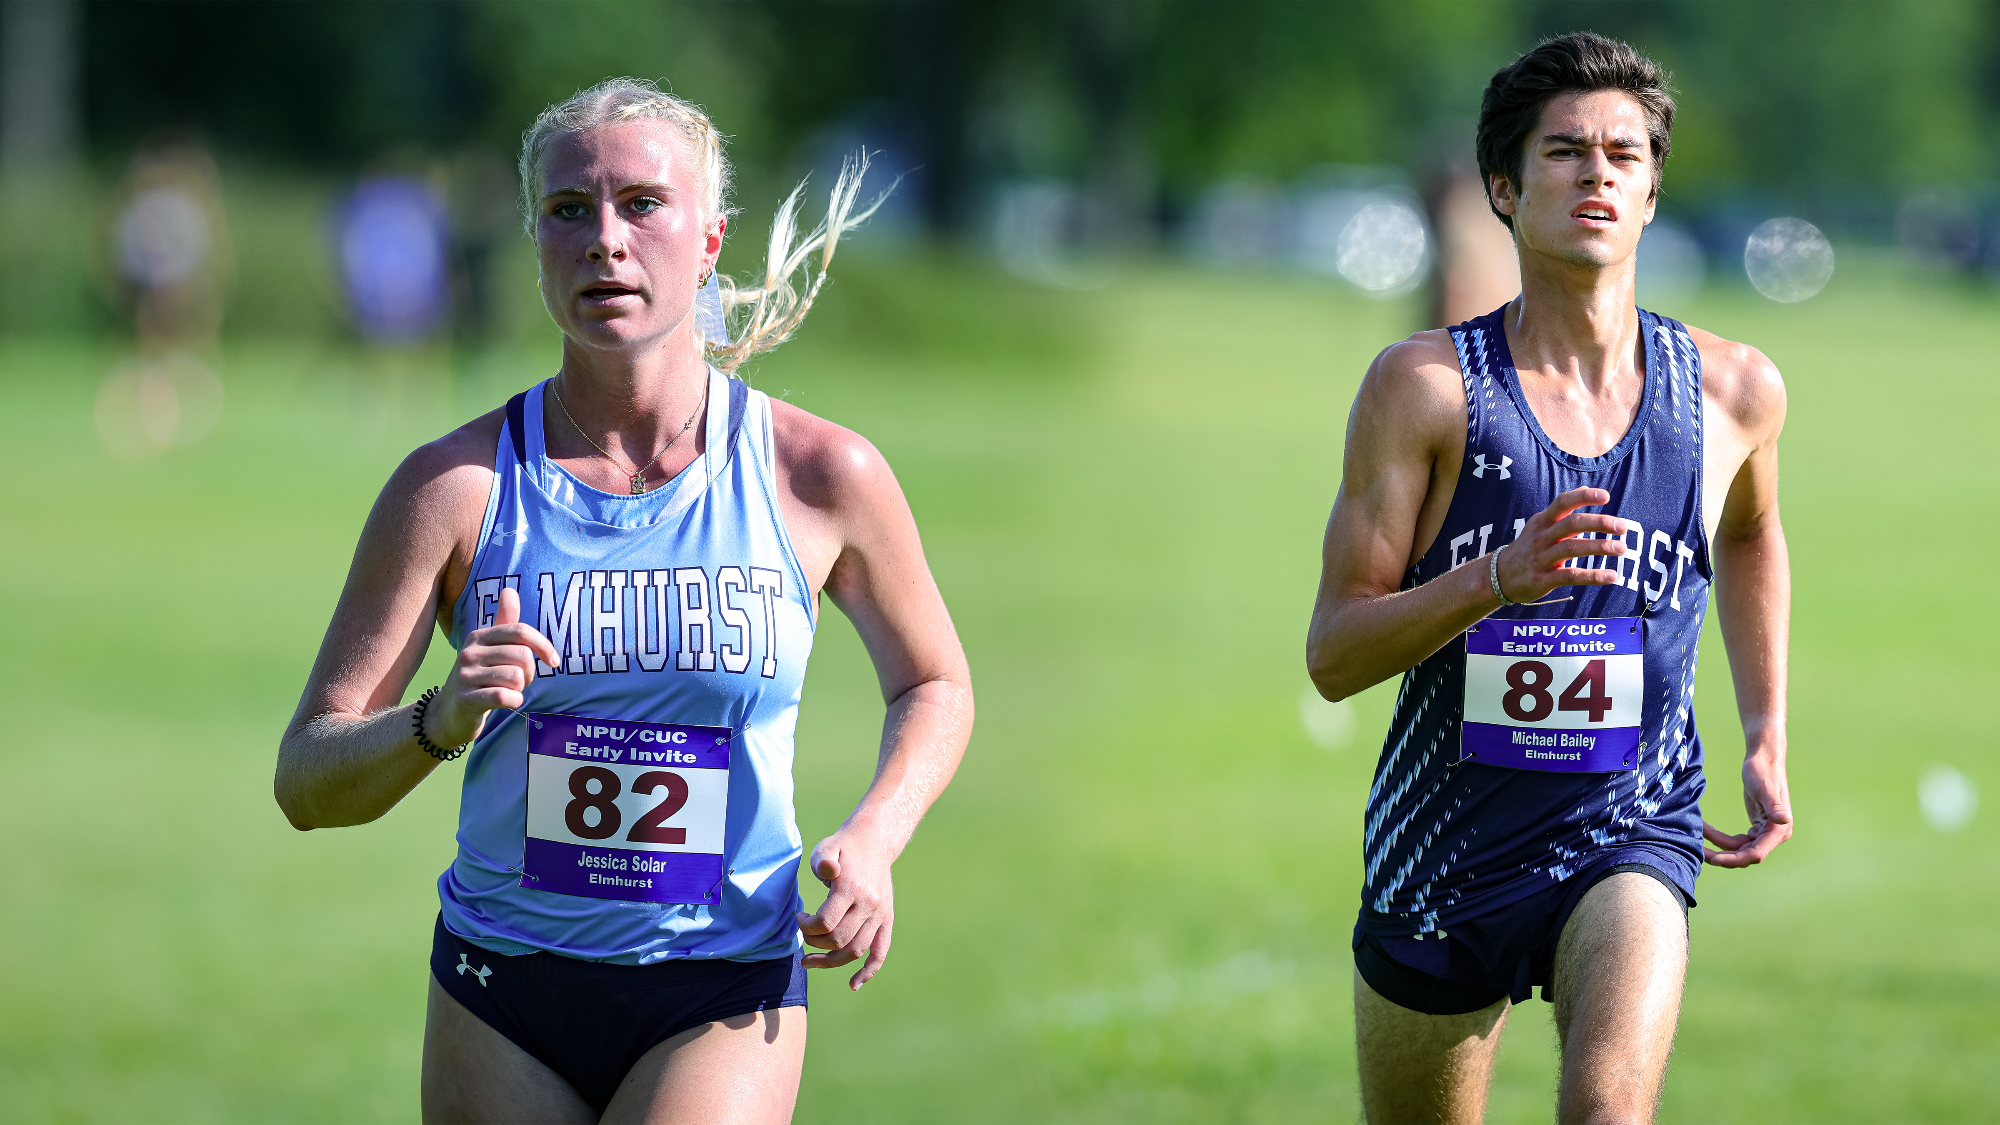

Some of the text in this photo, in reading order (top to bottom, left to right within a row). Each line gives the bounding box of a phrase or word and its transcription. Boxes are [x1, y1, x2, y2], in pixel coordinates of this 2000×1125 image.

[474, 565, 783, 680] EMHURST
[1512, 624, 1607, 638] NPU/CUC
[1502, 640, 1616, 656] Early Invite
[1502, 659, 1613, 722] 84
[576, 724, 688, 744] NPU/CUC
[1512, 731, 1596, 750] Michael Bailey
[565, 742, 697, 764] Early Invite
[1525, 750, 1581, 761] Elmhurst
[564, 766, 689, 845] 82
[577, 851, 667, 874] Jessica Solar
[589, 874, 653, 889] Elmhurst
